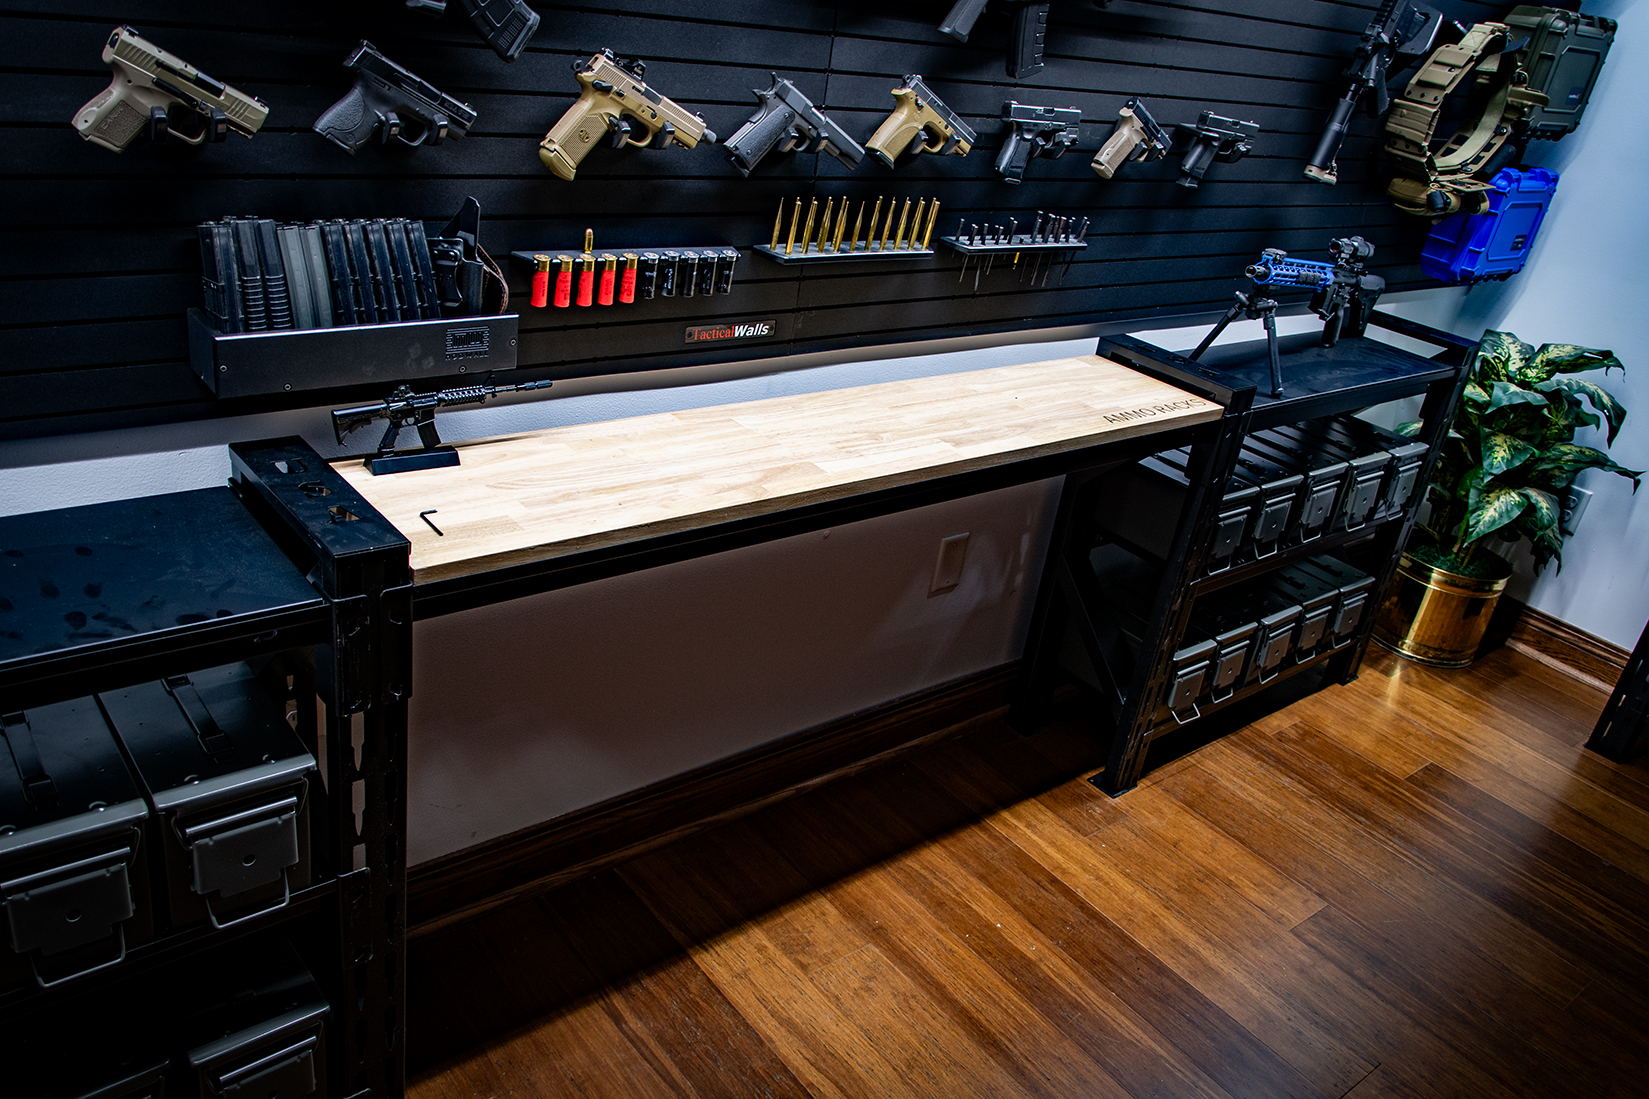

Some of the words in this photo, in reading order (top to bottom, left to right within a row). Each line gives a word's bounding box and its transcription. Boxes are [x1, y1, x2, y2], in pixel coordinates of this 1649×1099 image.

[101, 107, 124, 130] CANIK
[1103, 408, 1156, 424] AMMO
[1153, 398, 1207, 414] RACKS
